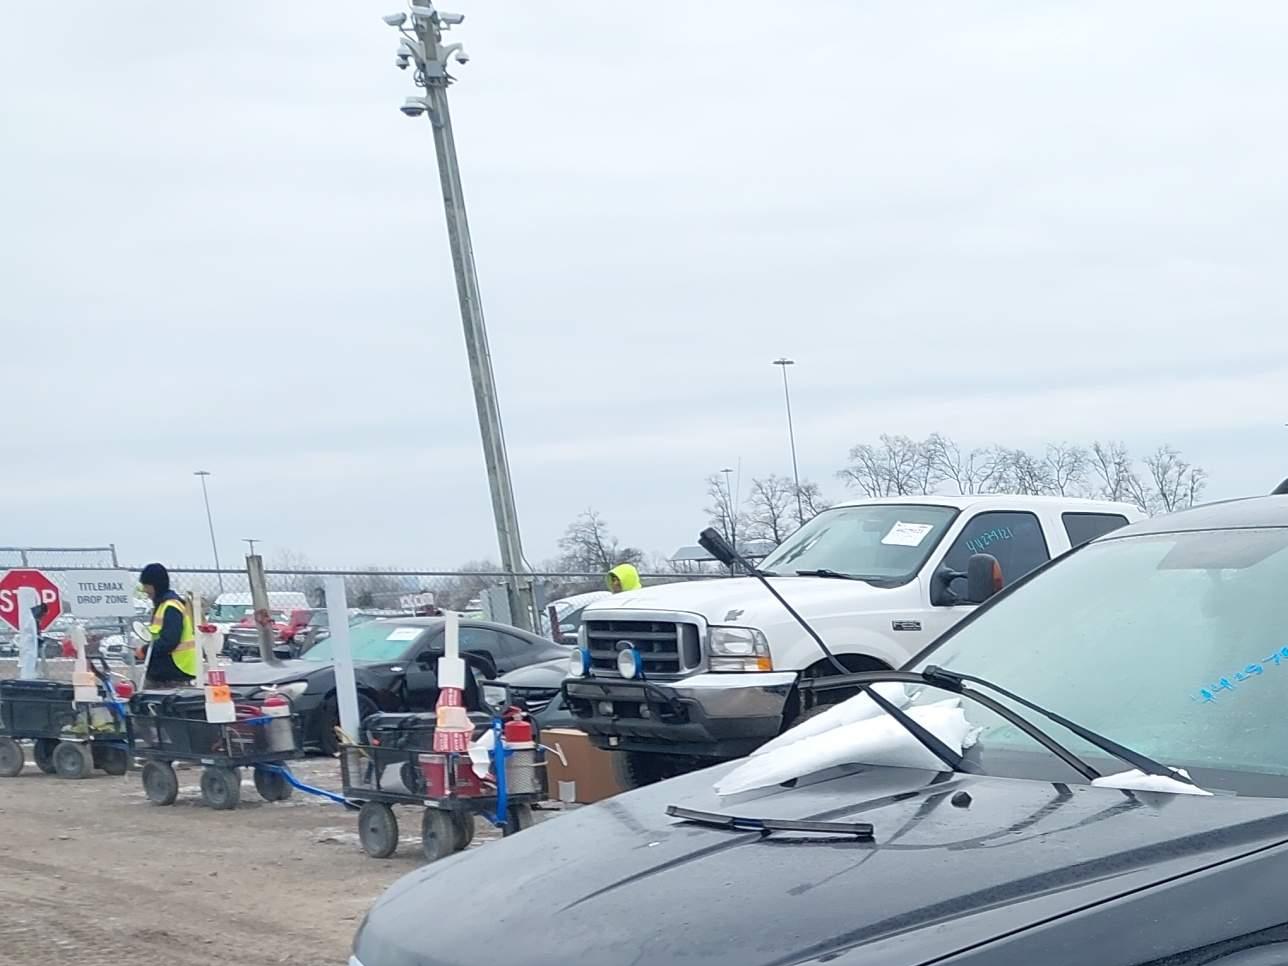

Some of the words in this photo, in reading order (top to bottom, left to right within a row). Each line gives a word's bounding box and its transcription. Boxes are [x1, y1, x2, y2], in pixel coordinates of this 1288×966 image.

[77, 582, 124, 592] TITLEMAX
[0, 588, 57, 612] SP
[76, 595, 103, 605] DROP
[105, 595, 129, 604] ZONE
